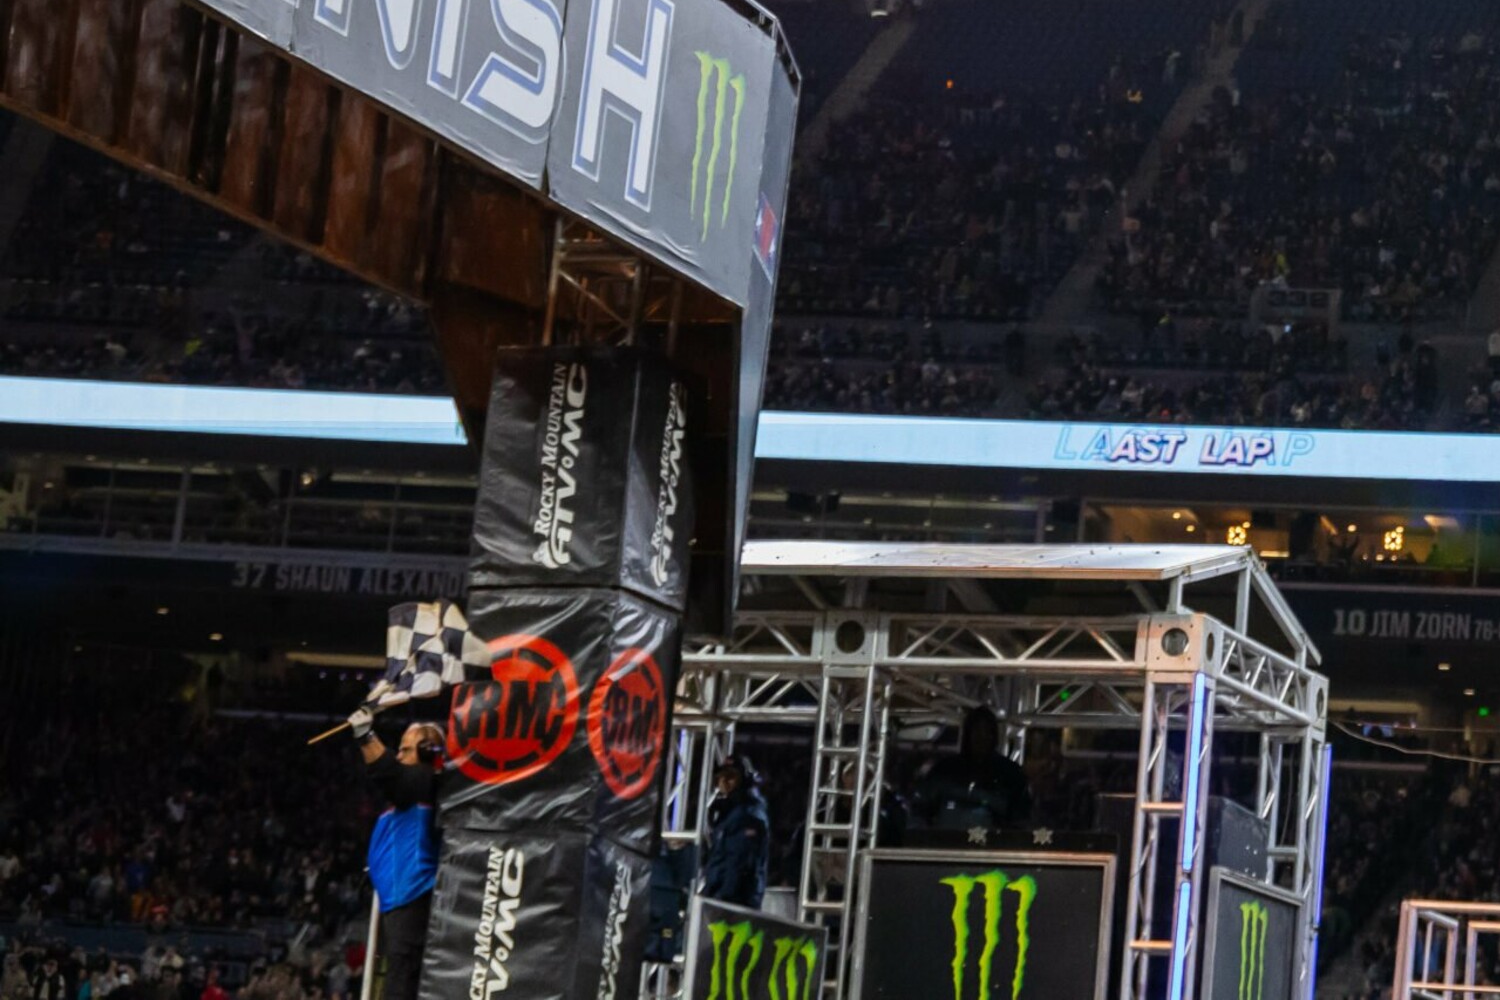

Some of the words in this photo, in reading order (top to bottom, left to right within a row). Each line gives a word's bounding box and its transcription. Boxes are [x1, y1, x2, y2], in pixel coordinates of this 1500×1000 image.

[541, 363, 567, 470] MOUNTAIN
[534, 471, 557, 537] ROCKY
[651, 491, 667, 550] ROCKY
[232, 563, 265, 588] 37
[275, 565, 350, 592] SHAUN
[1333, 609, 1367, 636] 10
[1369, 611, 1410, 638] JIM
[1415, 613, 1472, 640] ZORN
[474, 847, 504, 962] MOUNTAIN
